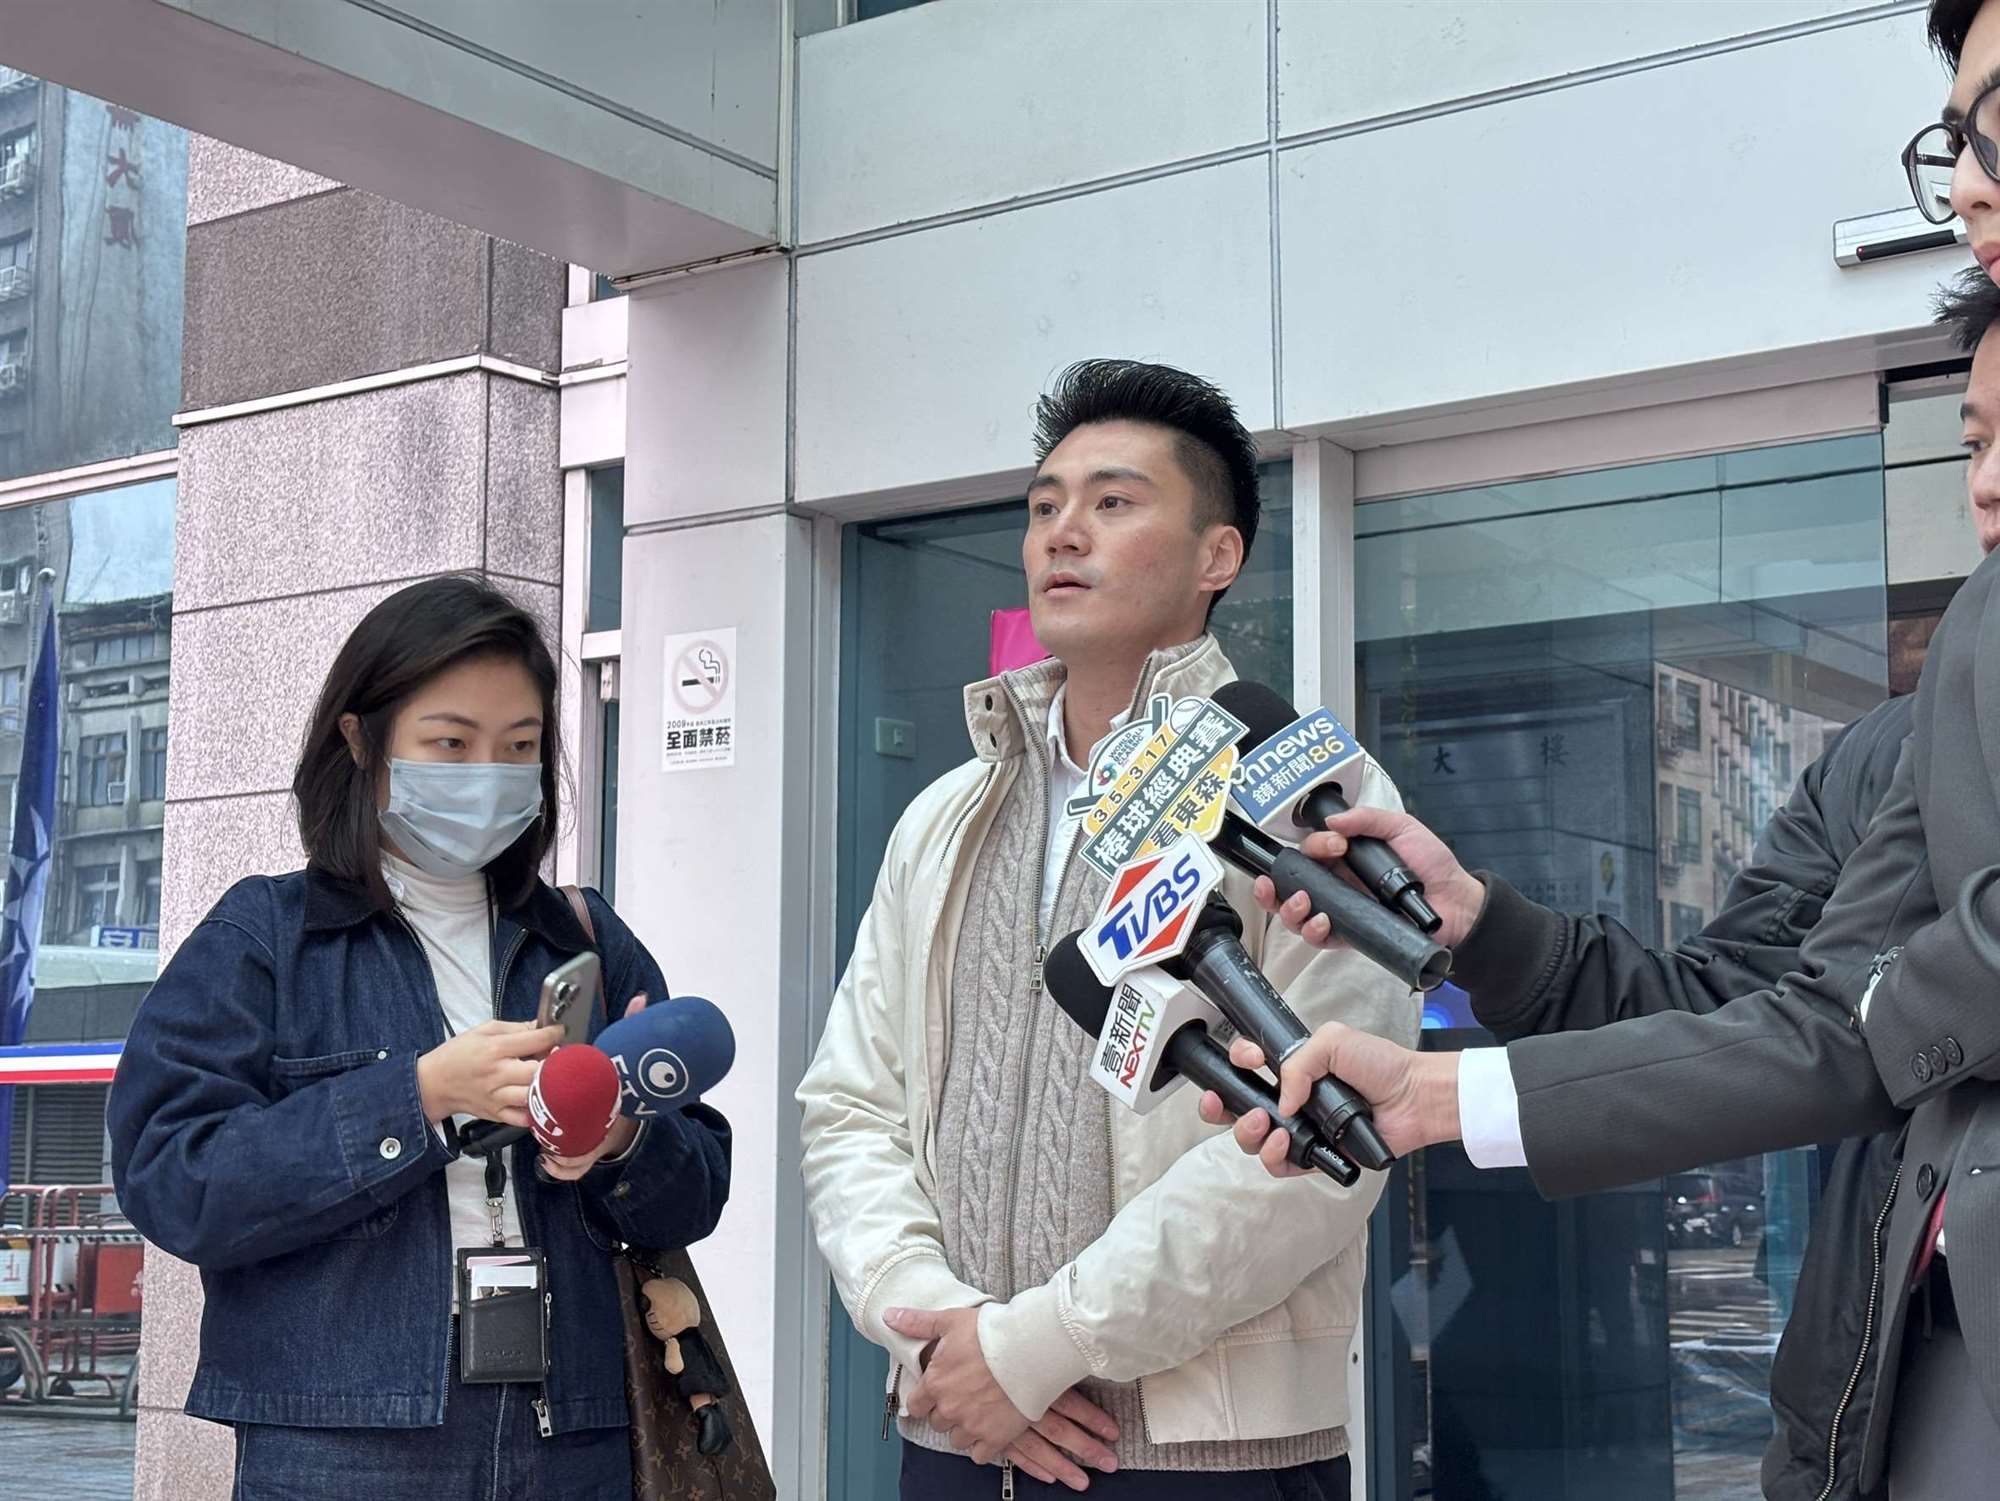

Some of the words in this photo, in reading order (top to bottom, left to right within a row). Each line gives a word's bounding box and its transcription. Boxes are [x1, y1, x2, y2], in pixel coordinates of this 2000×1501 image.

[666, 726, 731, 750] 全面禁菸
[1252, 752, 1315, 807] 鏡新聞
[1308, 735, 1345, 764] 86
[1093, 710, 1233, 868] 棒球經典賽
[1150, 770, 1226, 847] 看東森
[1098, 853, 1200, 960] TVBS
[1100, 983, 1143, 1078] 壹新聞
